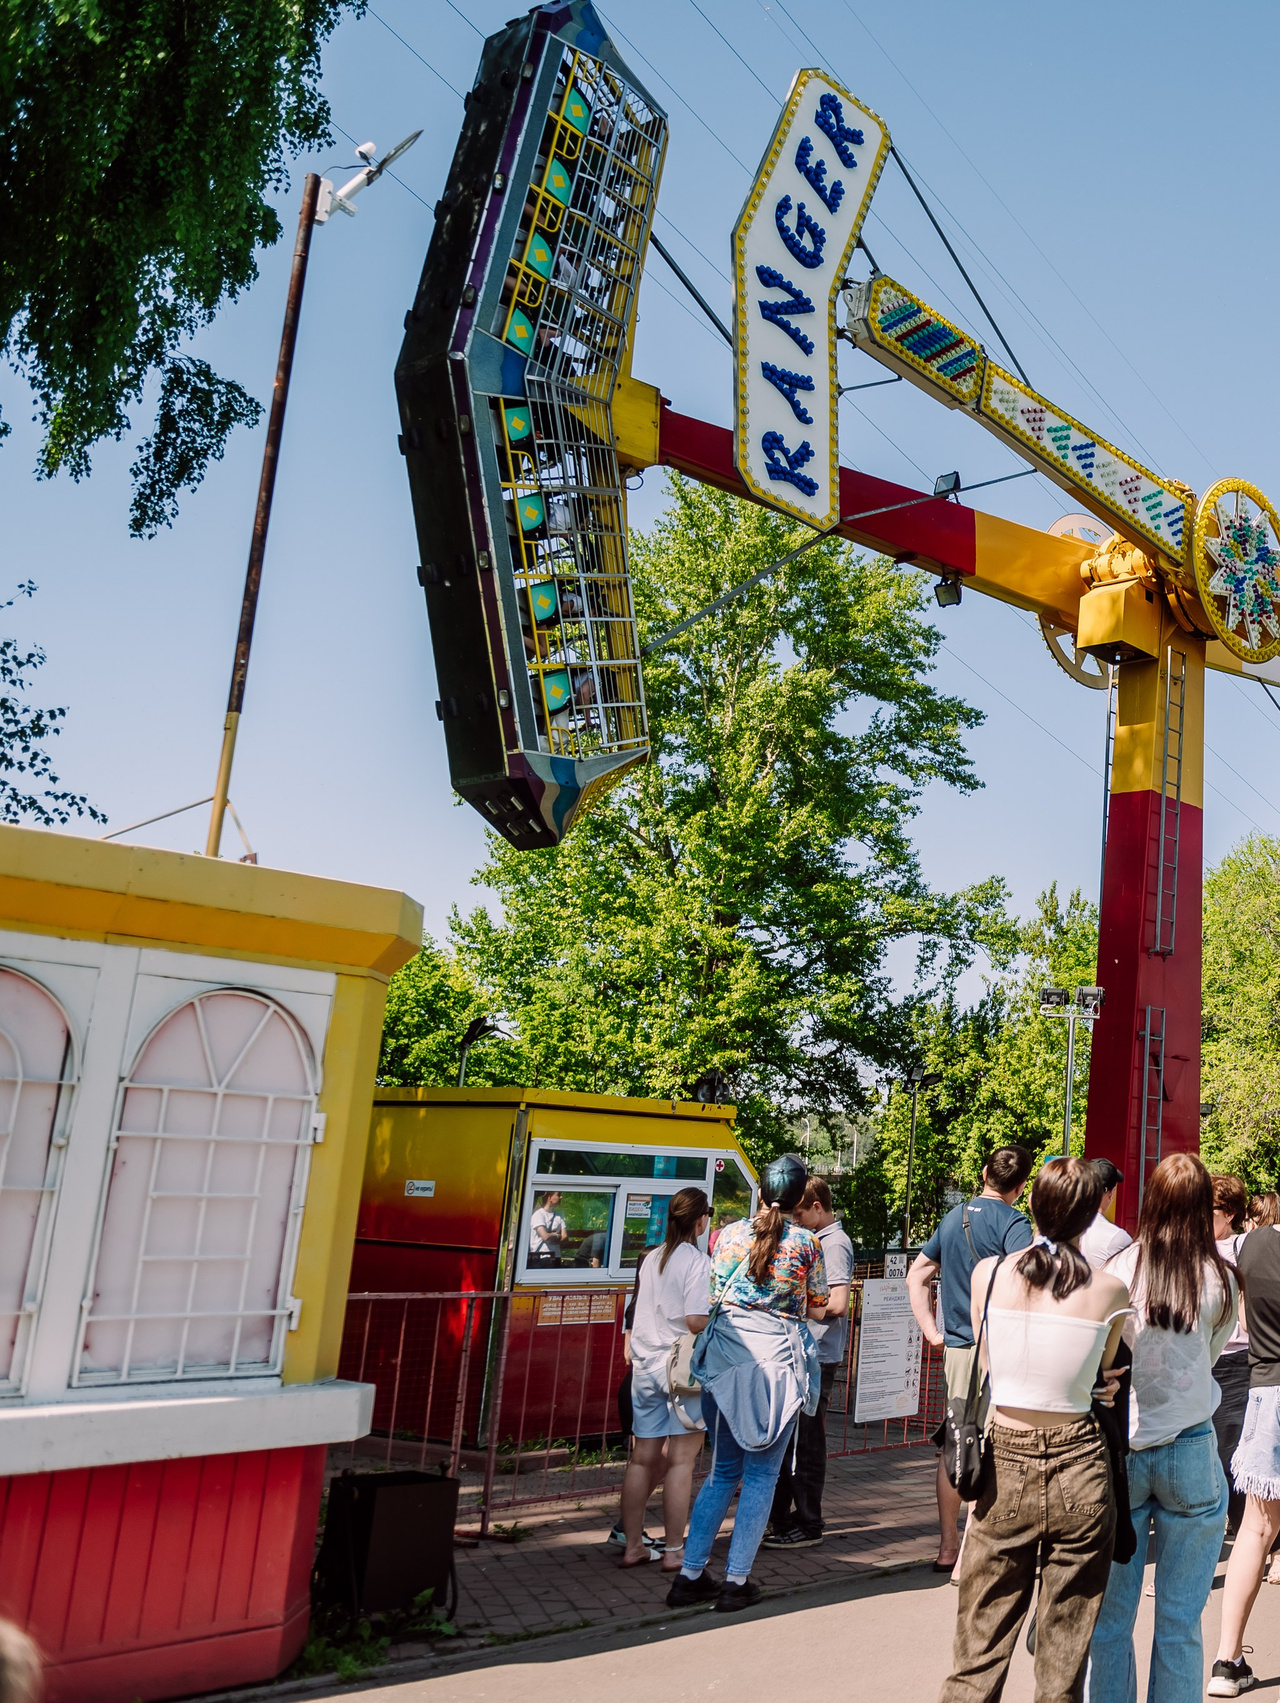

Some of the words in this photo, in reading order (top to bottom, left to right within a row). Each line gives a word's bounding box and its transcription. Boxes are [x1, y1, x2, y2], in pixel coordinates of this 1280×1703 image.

[756, 92, 865, 498] RANGER
[890, 1256, 897, 1264] 42
[888, 1268, 904, 1277] 0076
